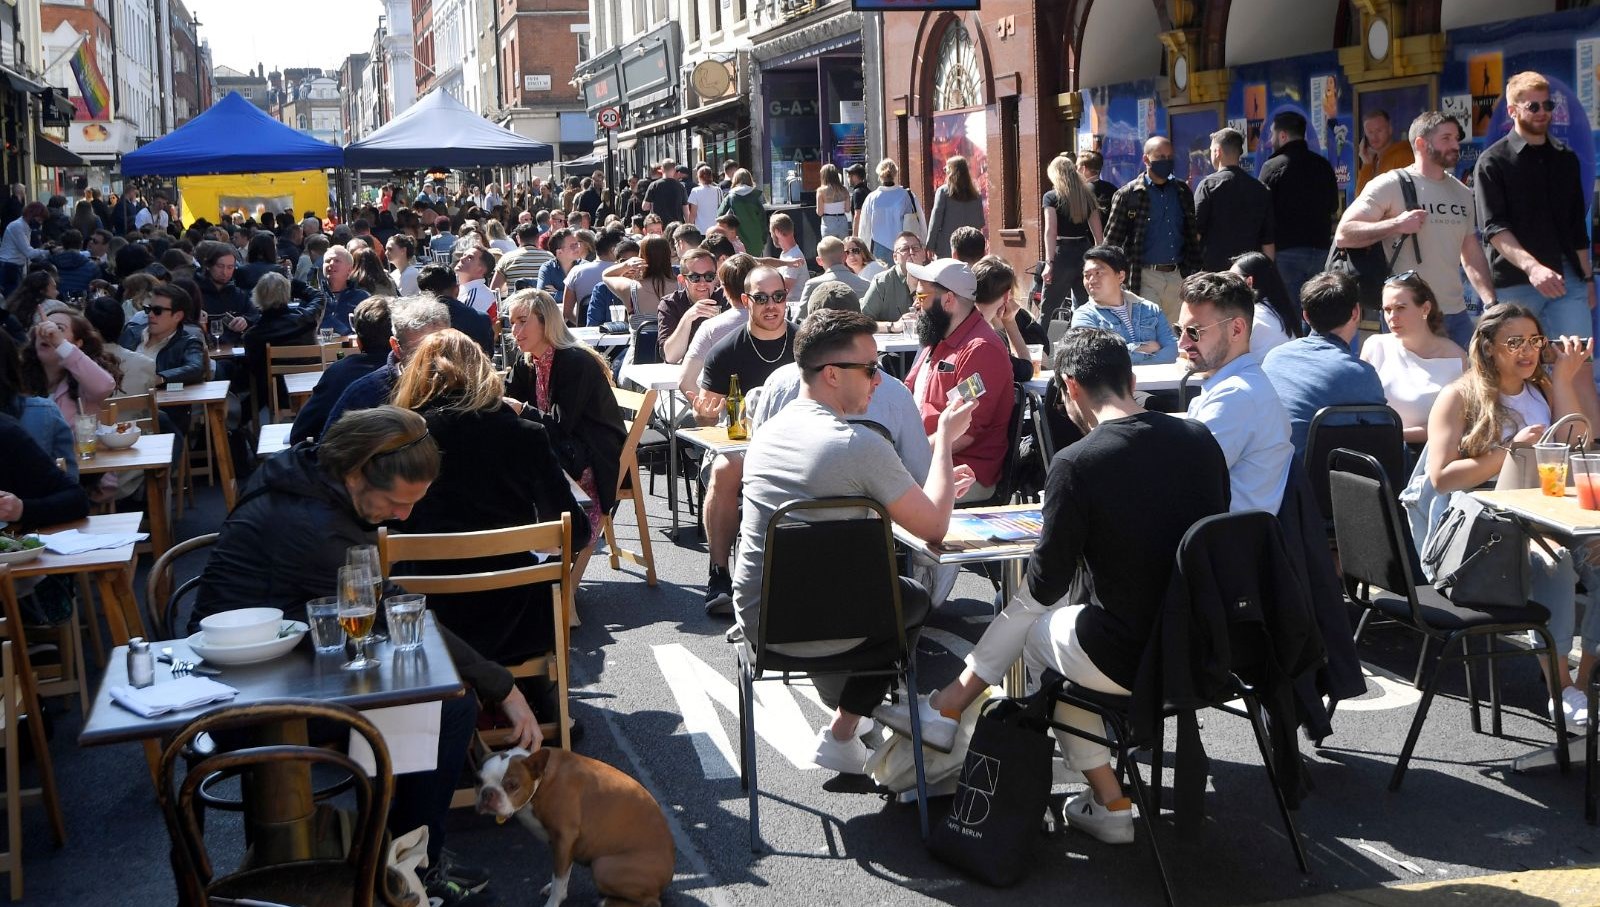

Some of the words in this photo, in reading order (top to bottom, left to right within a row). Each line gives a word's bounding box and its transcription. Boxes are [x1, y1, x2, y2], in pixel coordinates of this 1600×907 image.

[769, 100, 820, 116] G-A-Y
[602, 113, 617, 122] 20
[961, 827, 983, 839] BERLIN
